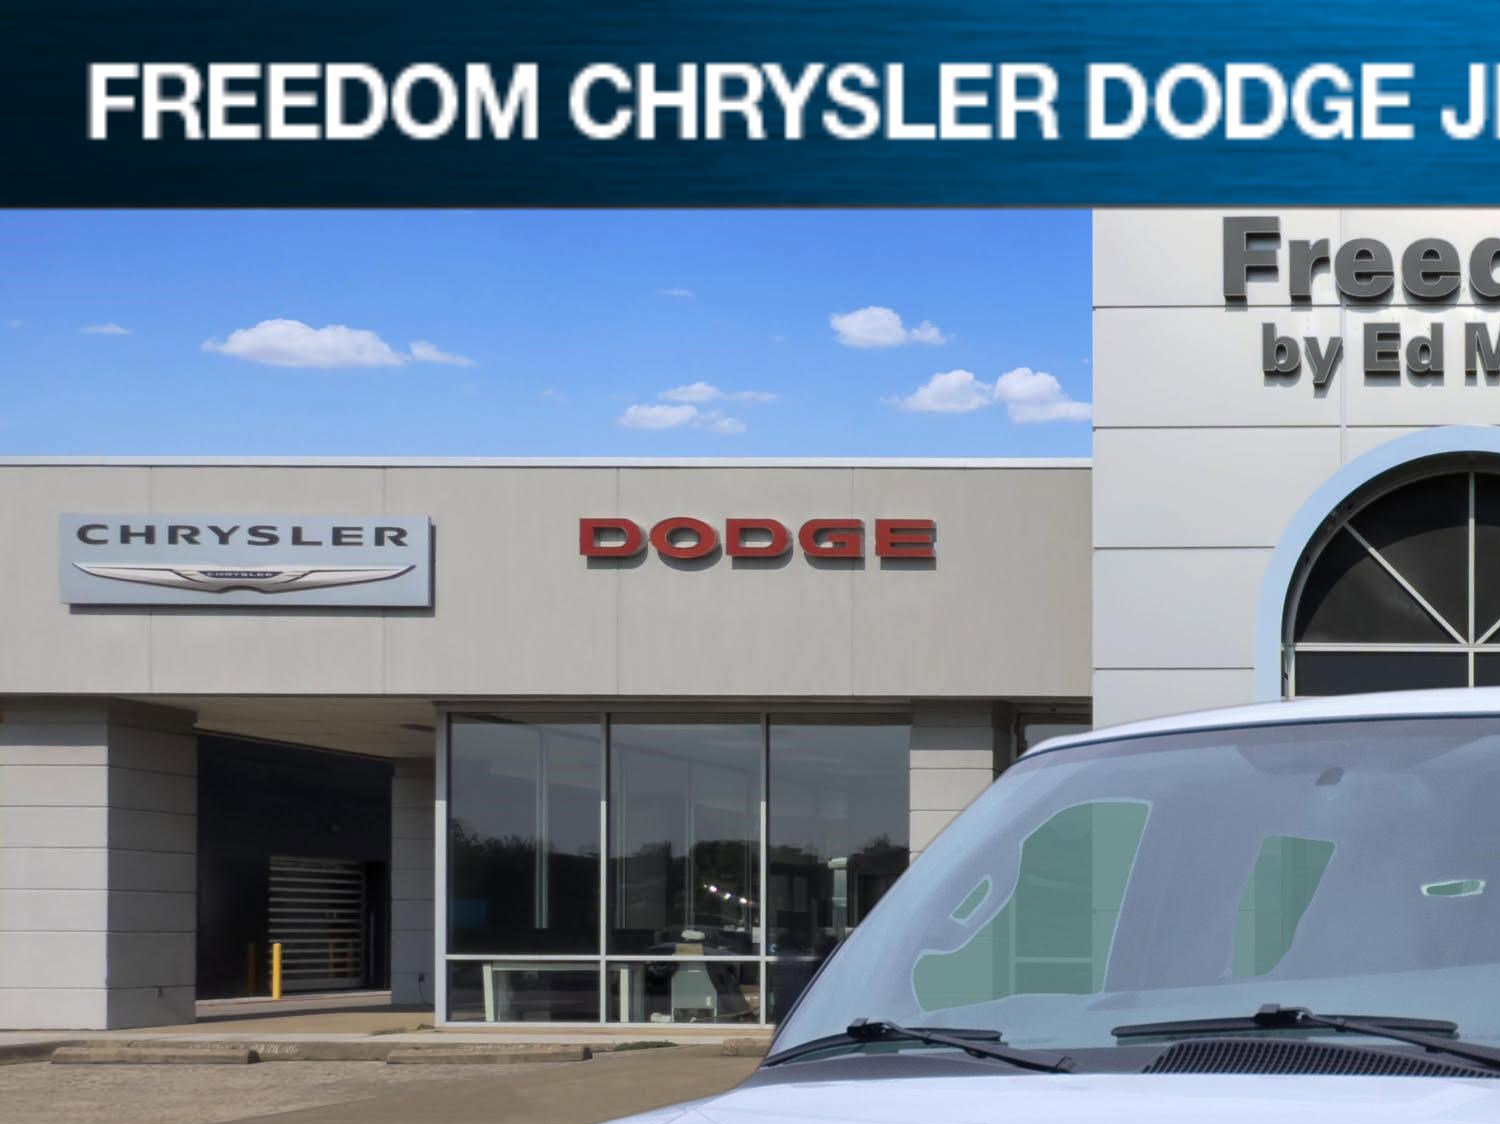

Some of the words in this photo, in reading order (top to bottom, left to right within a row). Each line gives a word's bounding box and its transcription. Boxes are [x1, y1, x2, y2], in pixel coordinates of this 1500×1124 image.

[1262, 322, 1343, 389] by
[1363, 322, 1445, 377] Ed
[76, 523, 409, 548] CHRYSLER
[579, 517, 936, 559] DODGE
[206, 571, 274, 579] CHRYSLER
